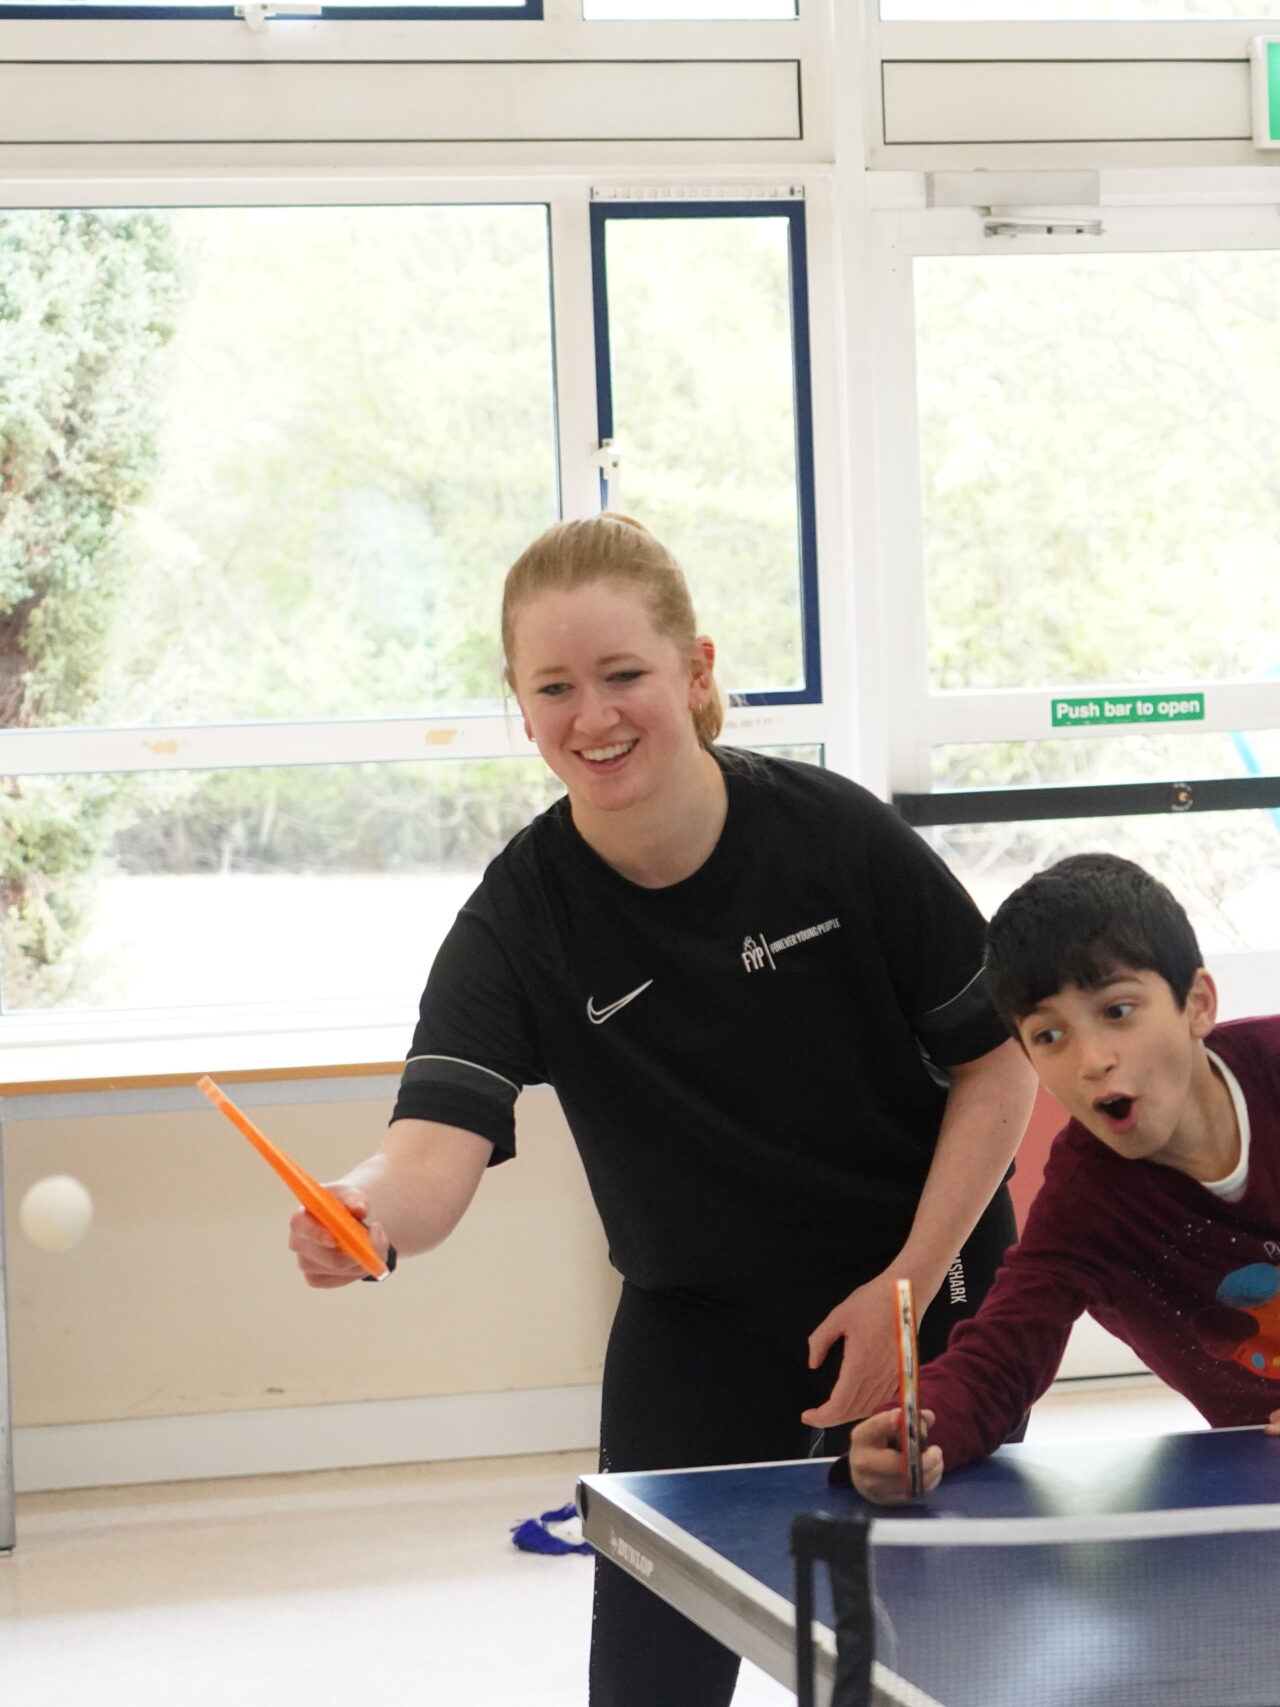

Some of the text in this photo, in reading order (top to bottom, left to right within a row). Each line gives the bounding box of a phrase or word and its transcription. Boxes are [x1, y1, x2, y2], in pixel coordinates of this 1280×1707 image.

[1056, 699, 1201, 720] Push bar to open
[769, 934, 799, 954] FOREVER
[796, 926, 819, 942] YOUNG
[741, 946, 765, 973] FYP
[617, 1536, 655, 1577] DUNLOP
